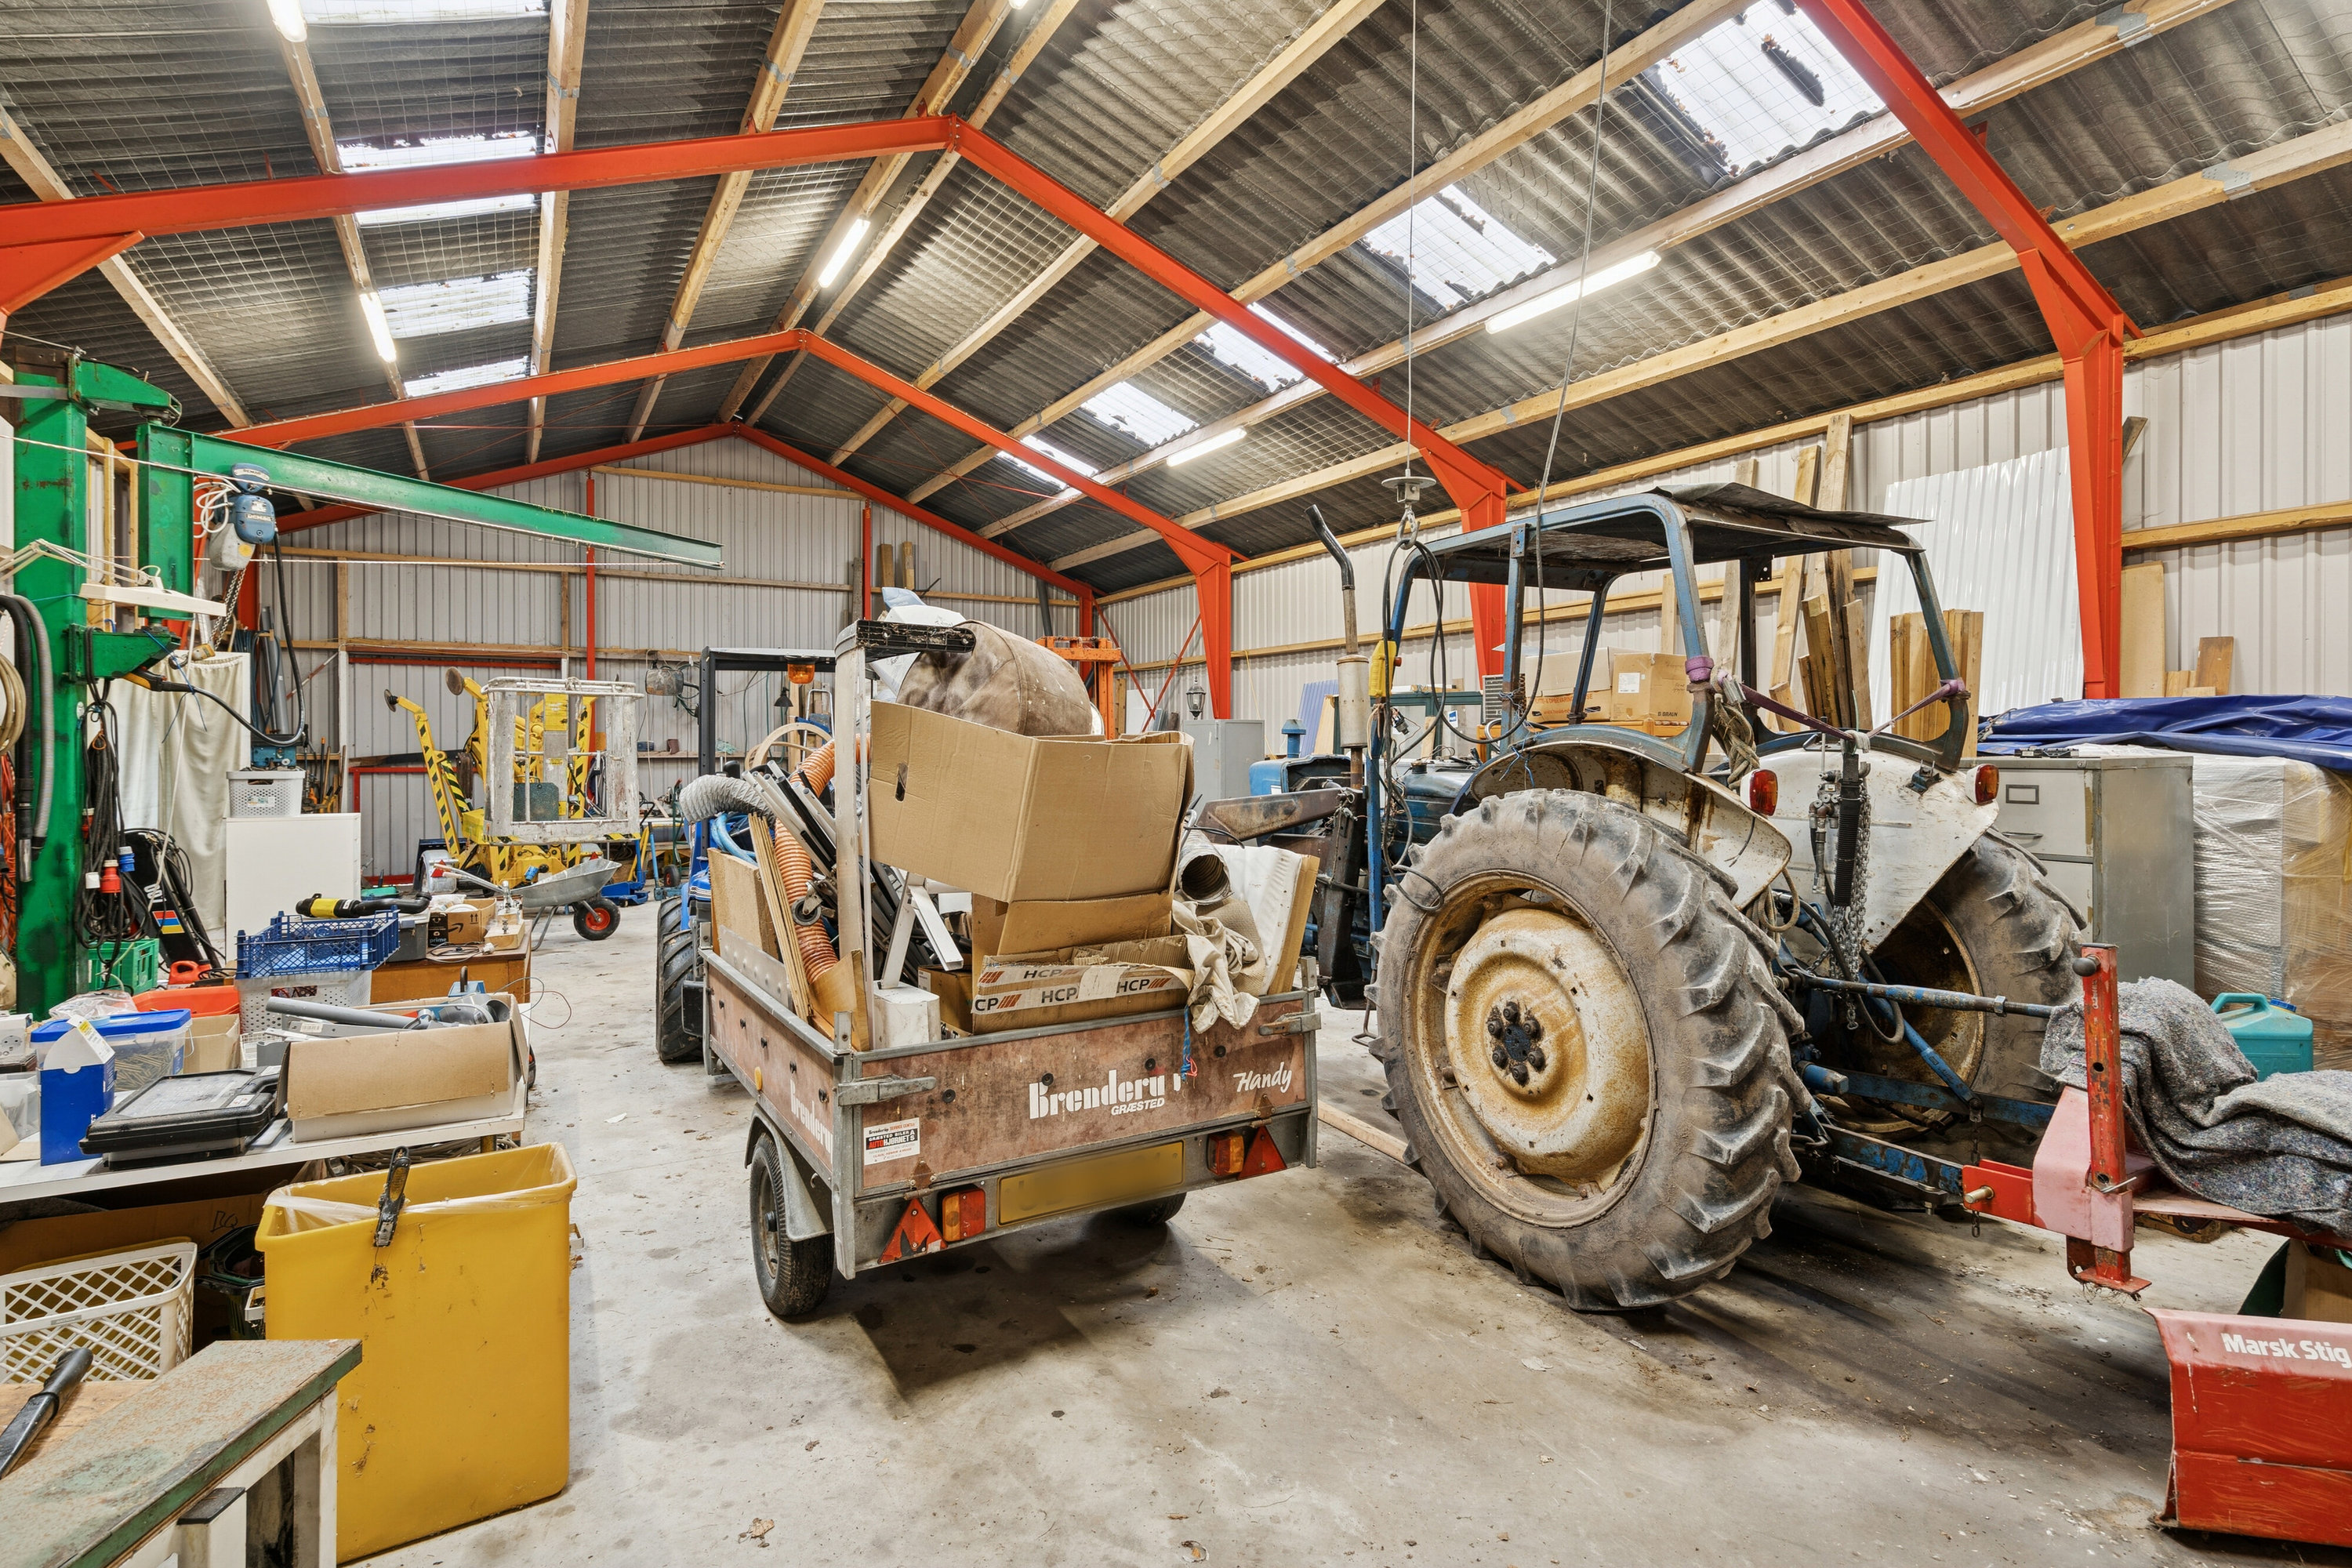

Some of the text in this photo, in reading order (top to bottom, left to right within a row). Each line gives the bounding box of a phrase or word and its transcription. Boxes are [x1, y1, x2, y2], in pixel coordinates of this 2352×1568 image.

[1023, 969, 1062, 979] HCP
[1116, 978, 1150, 993] HCP
[975, 987, 1077, 1011] CP HCP
[1232, 1062, 1293, 1093] Handy
[1111, 1098, 1165, 1116] GRÆSTED
[2220, 1333, 2352, 1369] Marsk Stig
